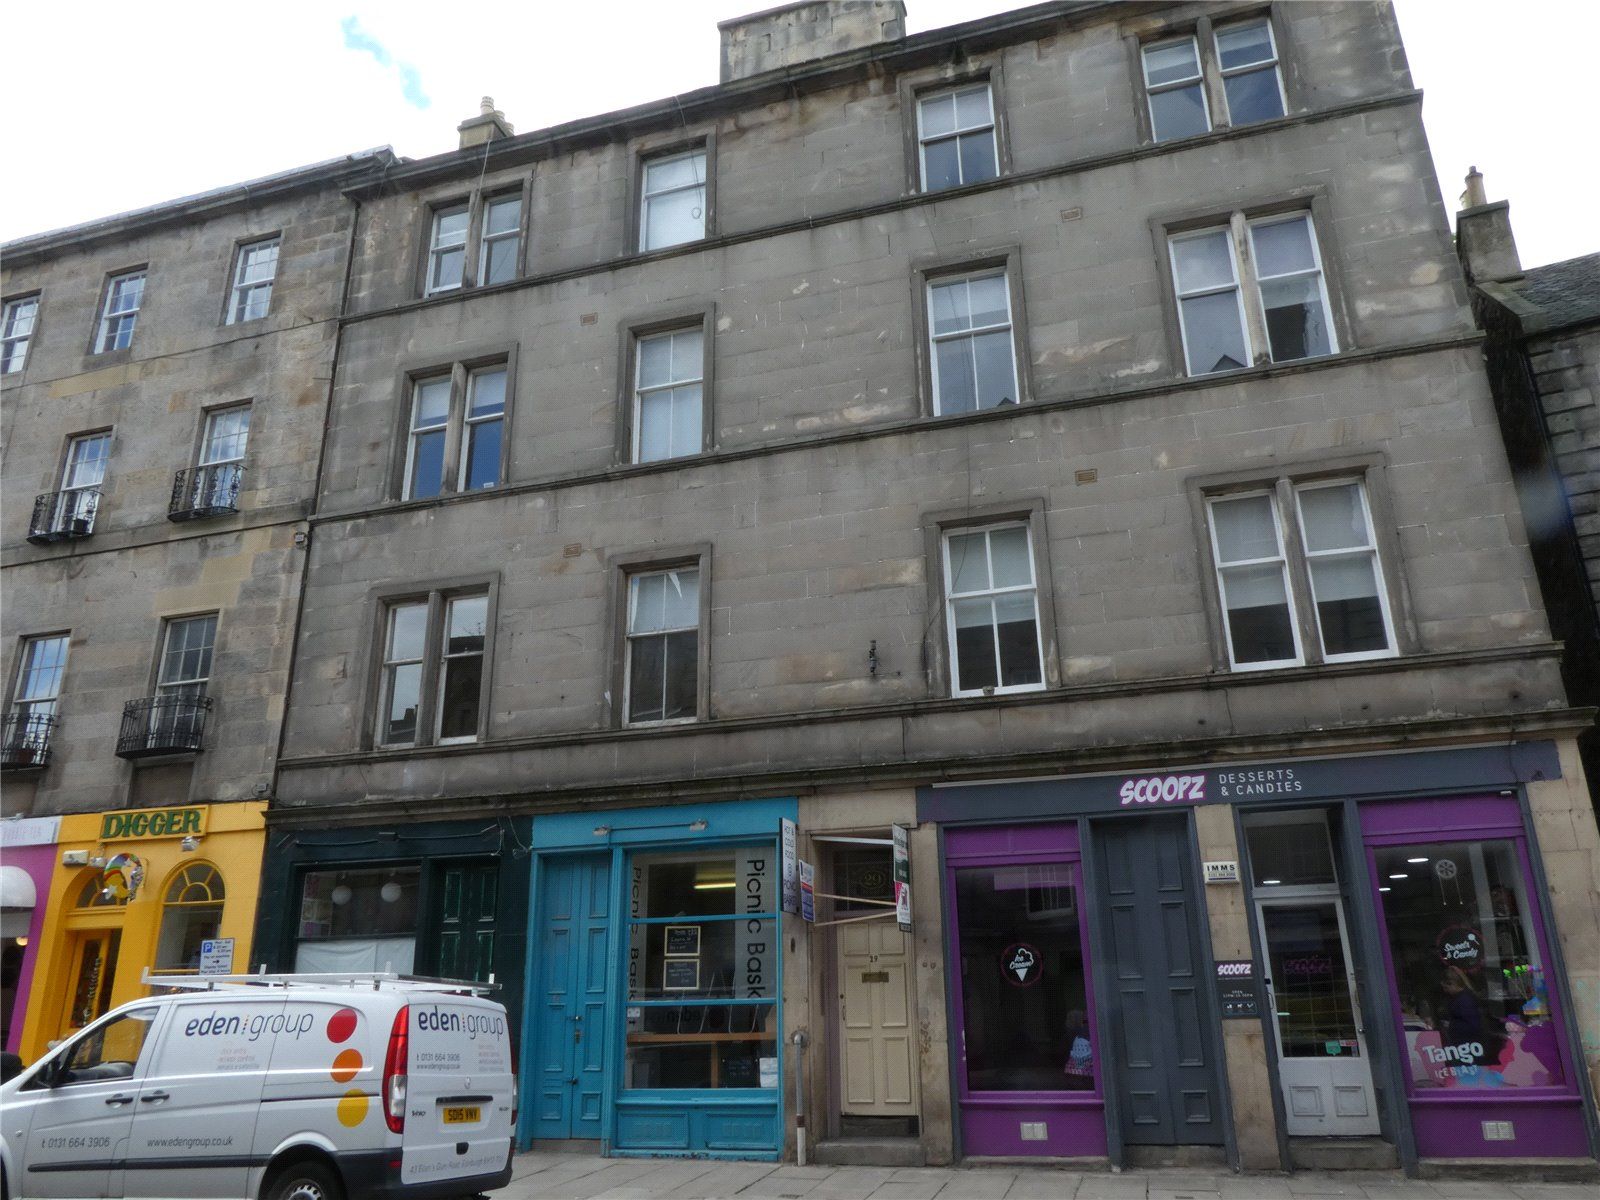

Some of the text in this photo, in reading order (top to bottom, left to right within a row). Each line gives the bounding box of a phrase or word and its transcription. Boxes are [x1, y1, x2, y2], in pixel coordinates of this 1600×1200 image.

[1218, 769, 1294, 784] DESSERTS
[1119, 775, 1205, 805] SCOOPZ
[1220, 781, 1302, 796] & CANDIES
[102, 809, 202, 839] DIGGER
[1206, 864, 1236, 872] IMMS
[1217, 963, 1252, 976] SCOOPZ
[184, 1010, 314, 1042] eden group
[418, 1005, 504, 1042] eden group
[1422, 1042, 1484, 1064] Tango
[48, 1137, 66, 1148] 0131
[68, 1137, 85, 1148] 664
[87, 1136, 110, 1148] 3906
[147, 1136, 233, 1150] www.edengroup.co.uk
